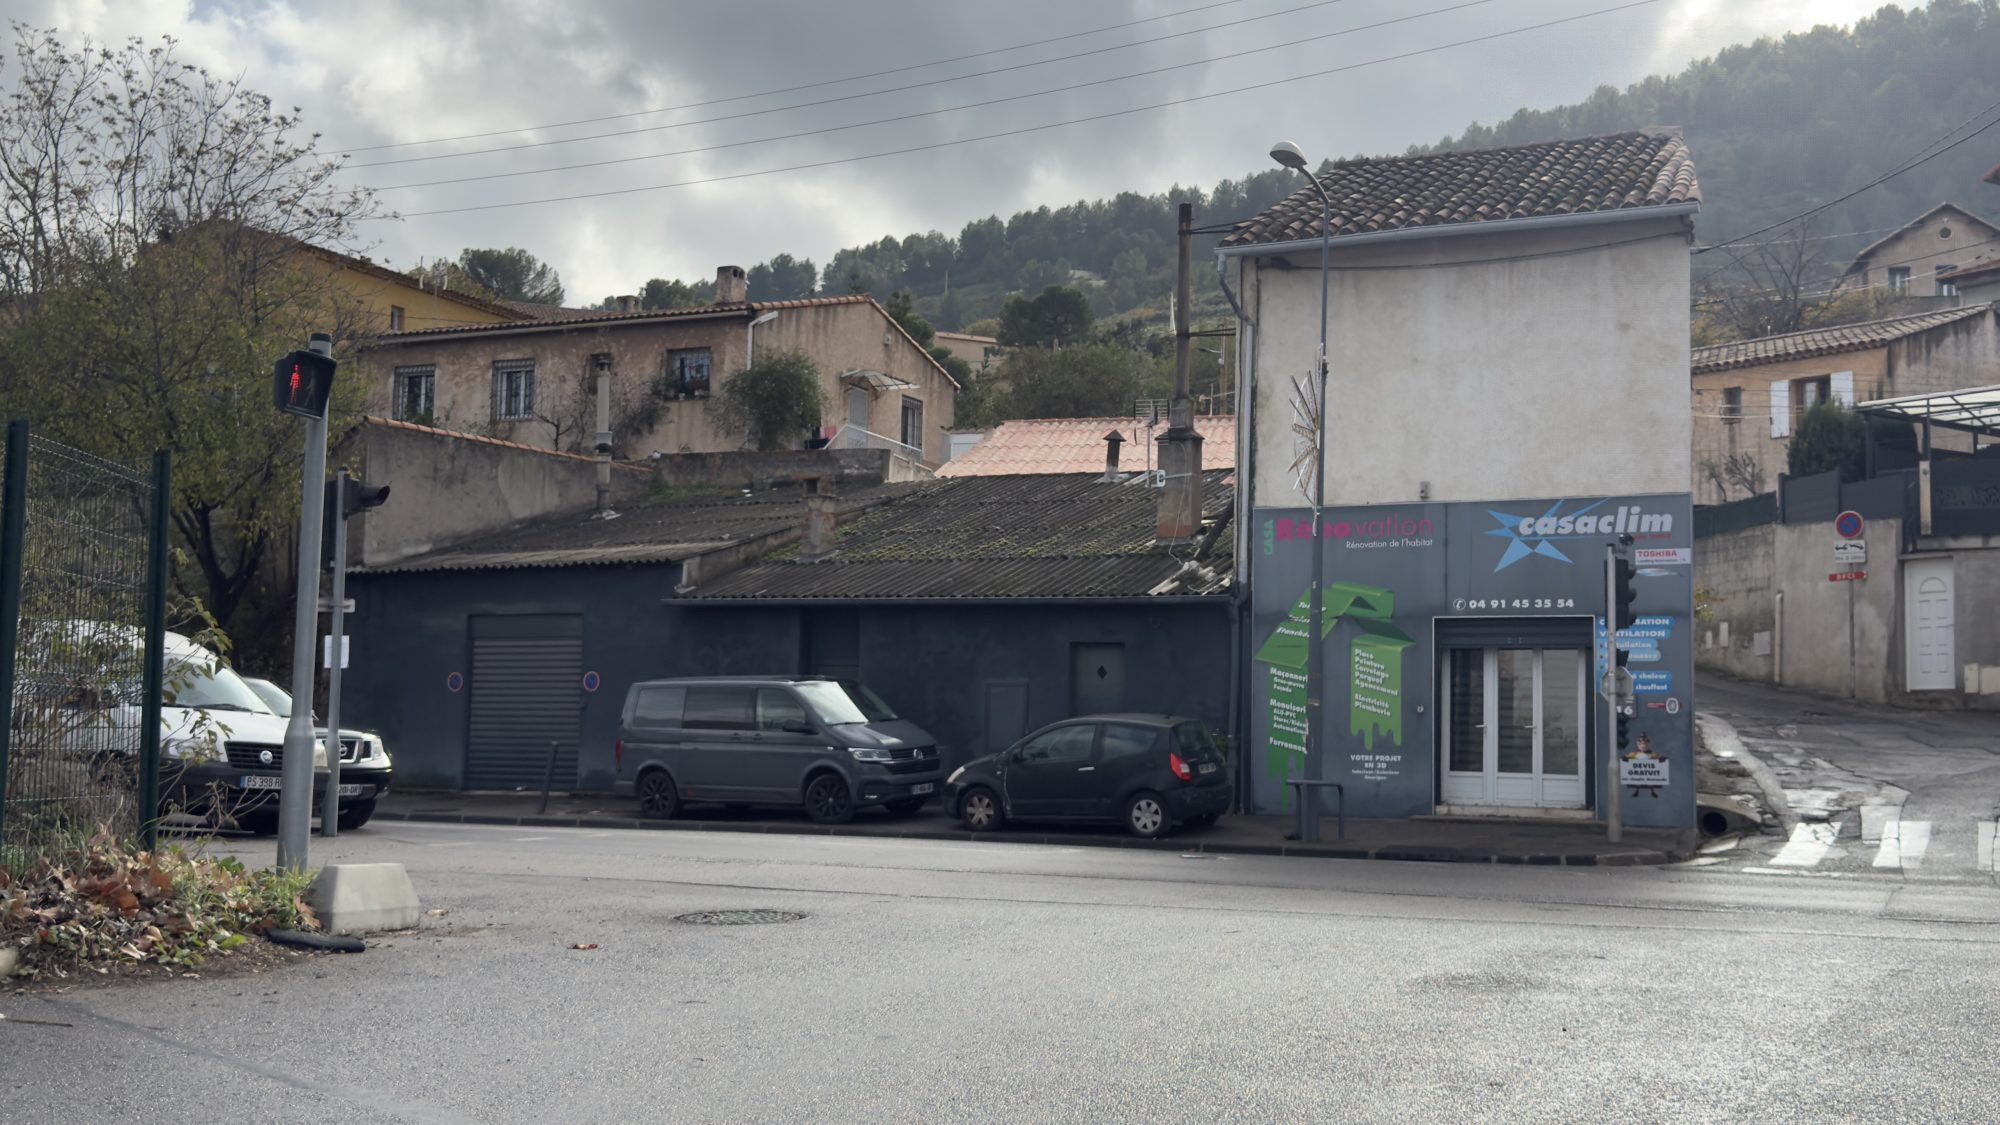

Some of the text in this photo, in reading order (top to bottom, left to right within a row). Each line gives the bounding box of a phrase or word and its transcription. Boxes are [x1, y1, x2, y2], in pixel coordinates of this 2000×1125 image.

[1518, 506, 1672, 535] casaclim
[1264, 520, 1274, 556] CASA
[1346, 538, 1433, 549] Rénovation de l'habitat
[1637, 550, 1678, 558] TOSHIBA
[1469, 599, 1574, 608] 04 91 45 35 54
[1355, 656, 1385, 670] Peinture
[1270, 667, 1309, 683] Maçonneri
[1355, 664, 1389, 679] Carrelage
[1355, 671, 1383, 684] Parquet
[1355, 679, 1398, 696] Agencement
[1270, 698, 1307, 714] Menuiseri
[1355, 700, 1391, 716] Plomberie
